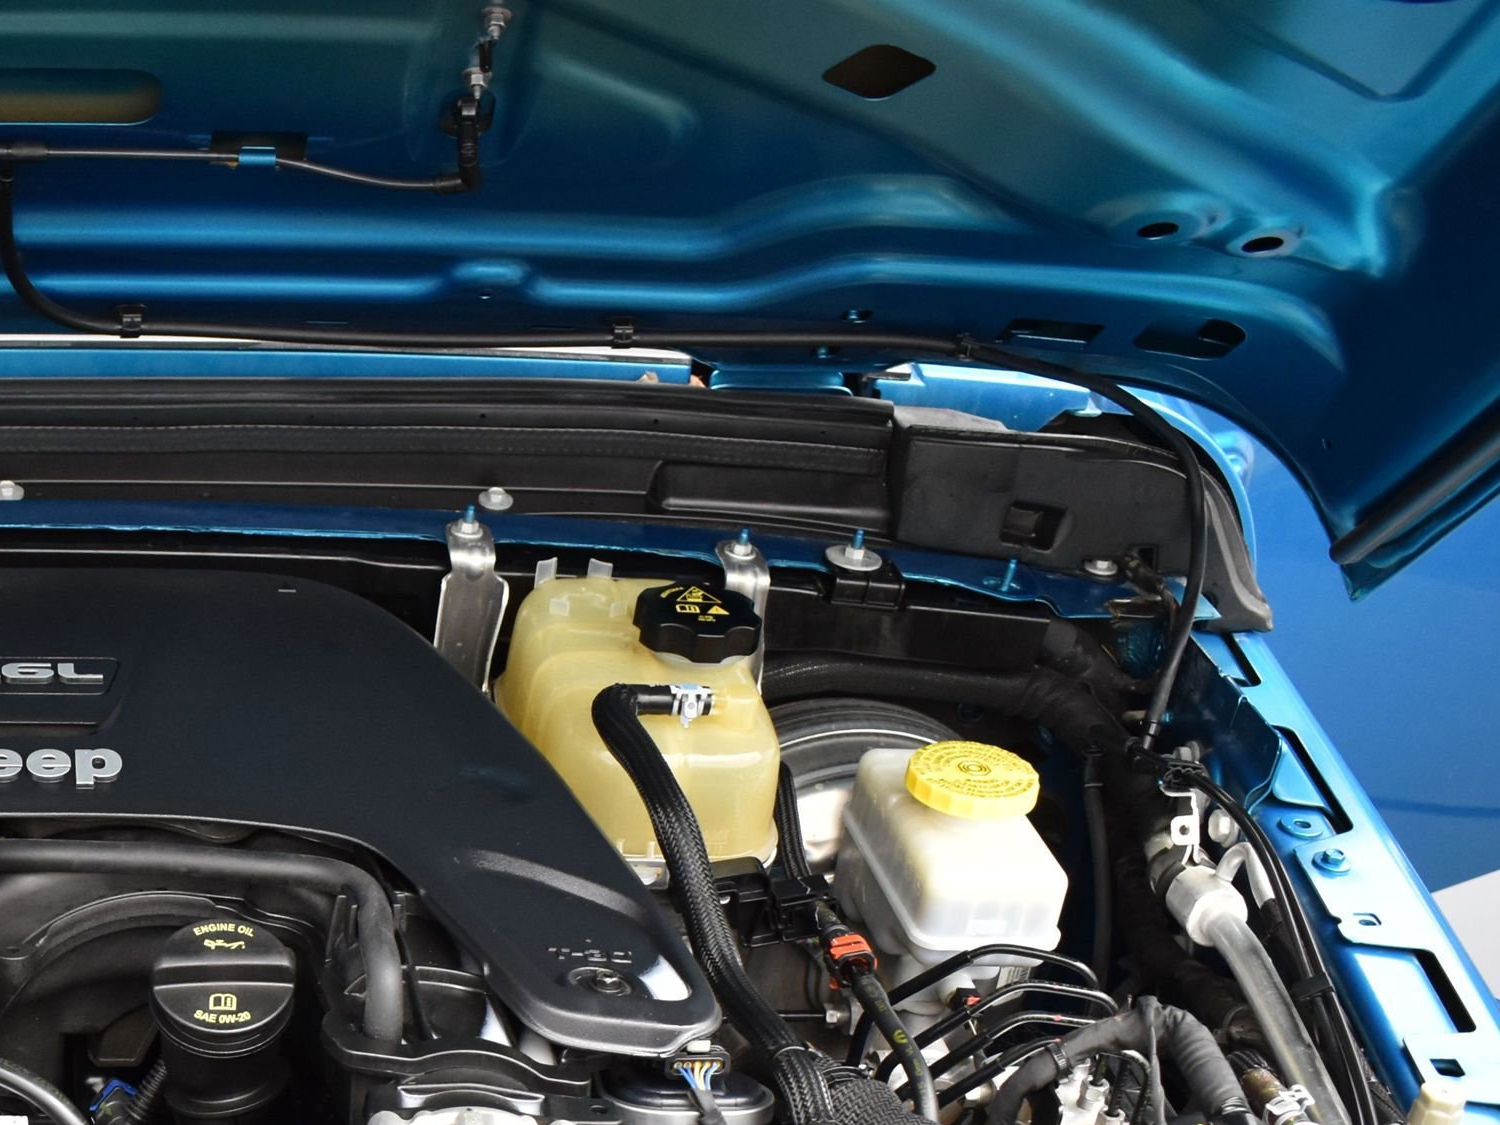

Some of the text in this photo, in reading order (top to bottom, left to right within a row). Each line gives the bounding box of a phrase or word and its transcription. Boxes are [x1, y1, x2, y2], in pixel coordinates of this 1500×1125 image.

[193, 923, 255, 937] ENGINE OIL
[193, 1010, 251, 1024] SAE 0W-20
